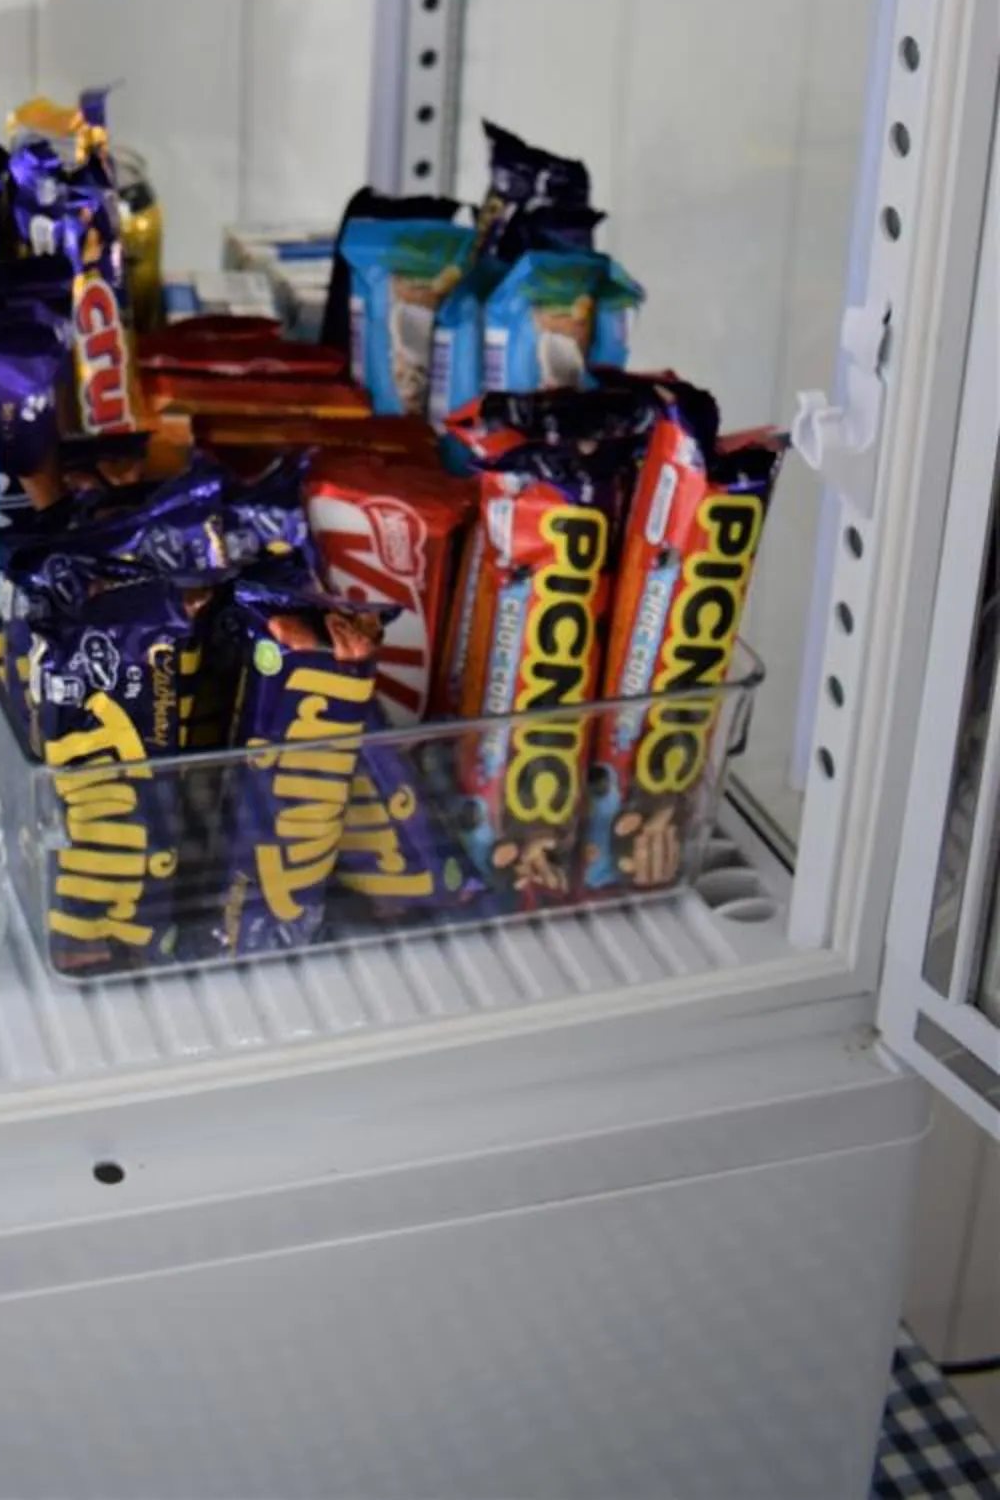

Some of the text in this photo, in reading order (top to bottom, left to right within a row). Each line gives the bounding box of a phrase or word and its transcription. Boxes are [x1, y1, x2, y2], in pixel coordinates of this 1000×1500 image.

[511, 512, 602, 818] PICNIC
[642, 500, 758, 789] PICNIC
[45, 690, 178, 946] Twirl
[247, 667, 376, 923] Twirl
